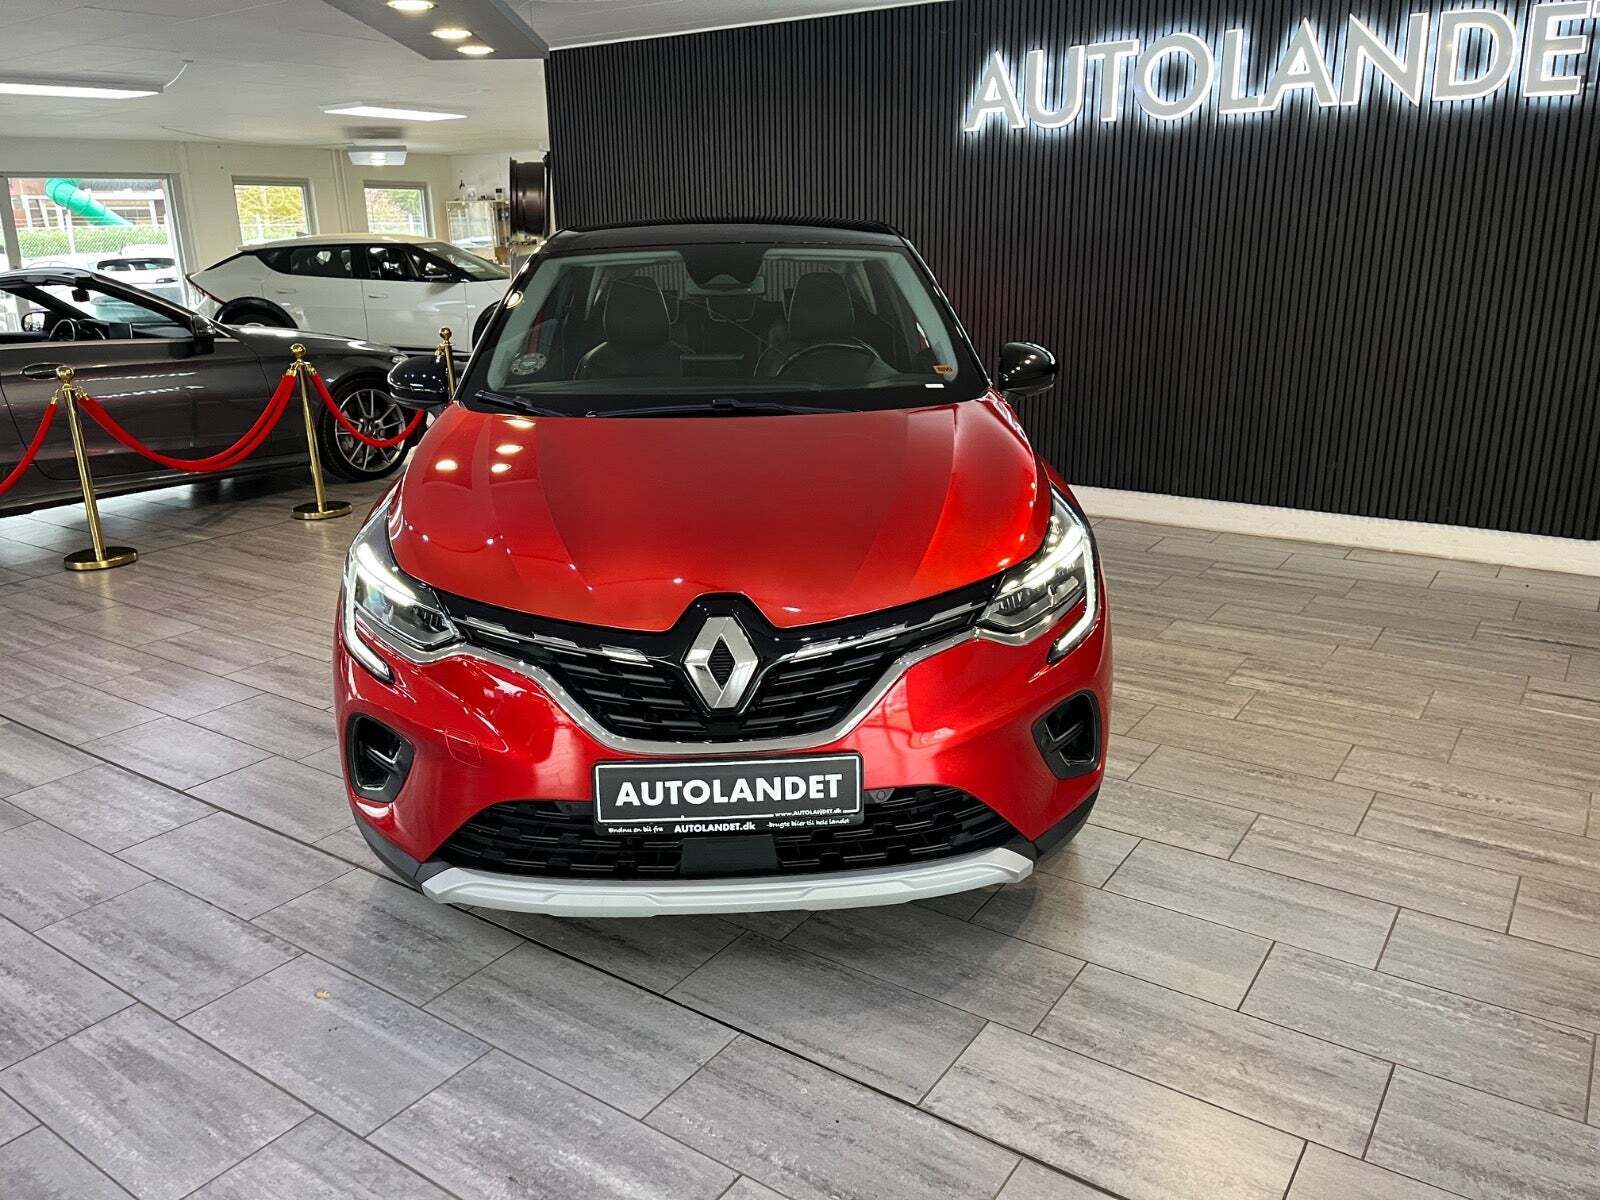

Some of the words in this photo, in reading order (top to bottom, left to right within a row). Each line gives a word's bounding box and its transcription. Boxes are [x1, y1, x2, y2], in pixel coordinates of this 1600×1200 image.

[964, 0, 1600, 132] AUTOLANDE
[615, 773, 843, 807] AUTOLANDET
[674, 821, 756, 833] AUTOLANDET.dk
